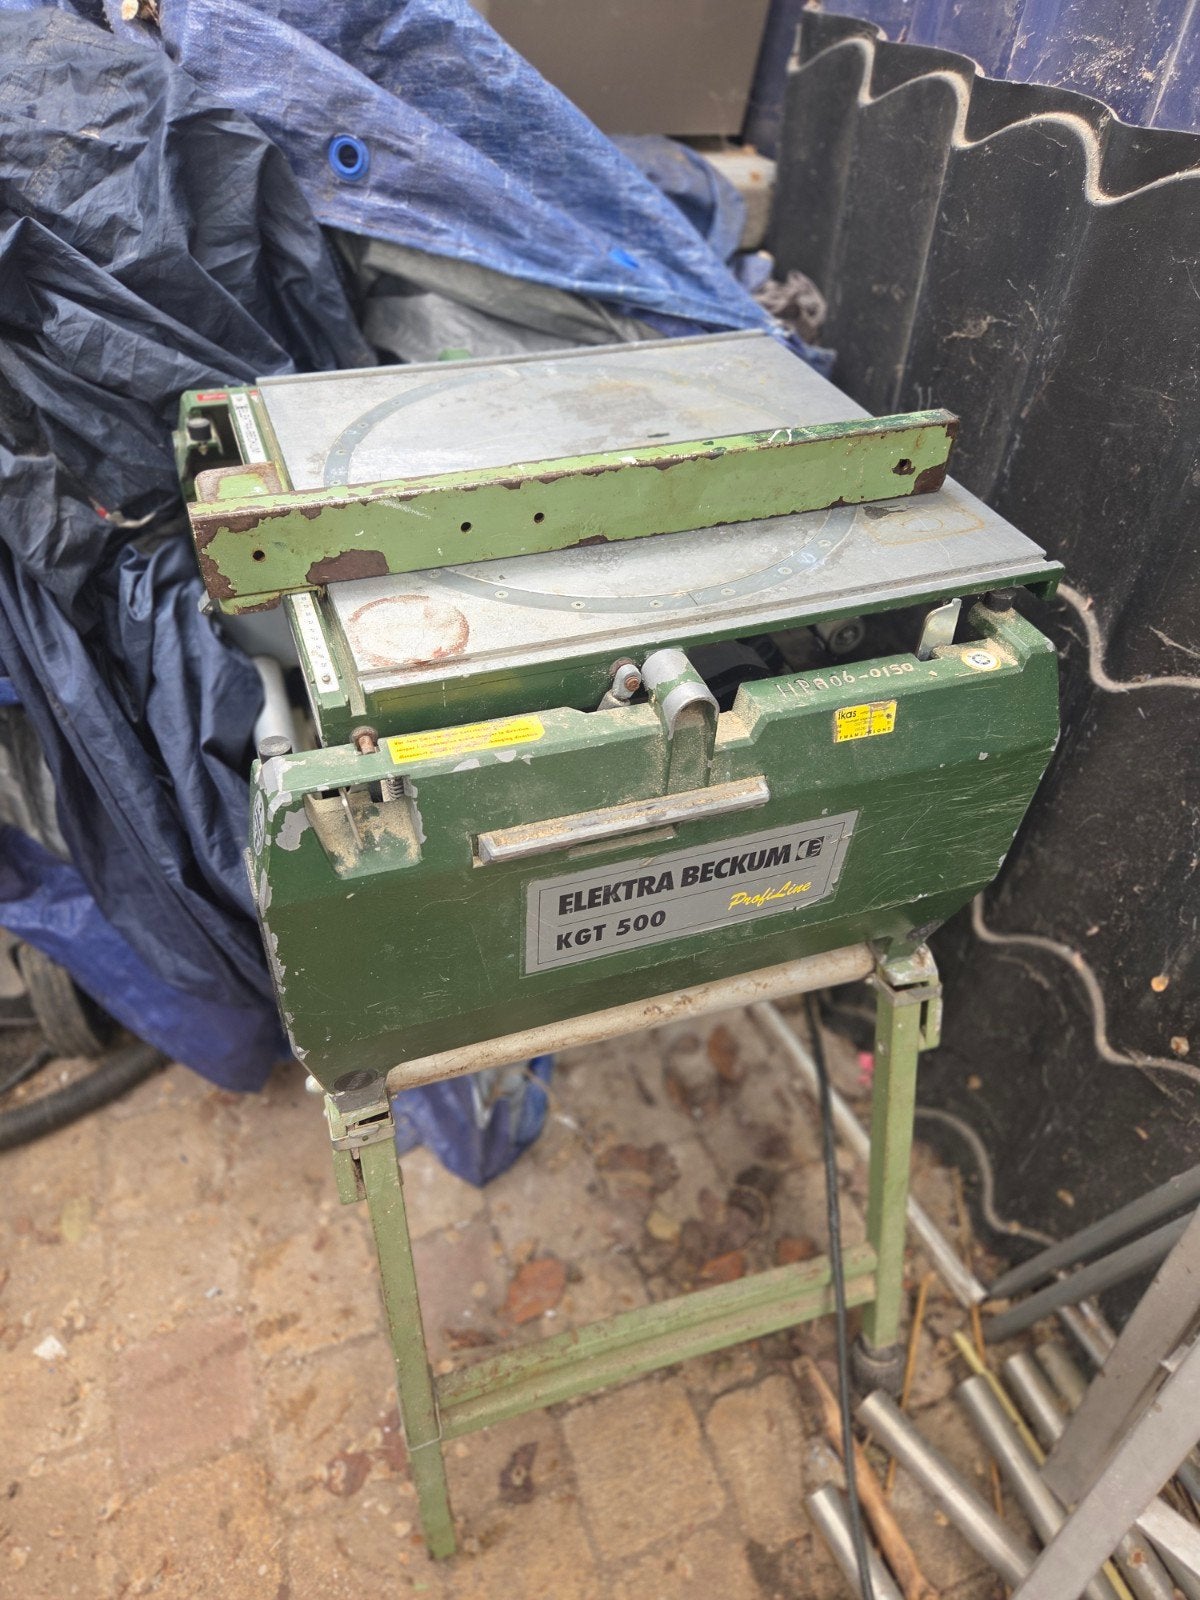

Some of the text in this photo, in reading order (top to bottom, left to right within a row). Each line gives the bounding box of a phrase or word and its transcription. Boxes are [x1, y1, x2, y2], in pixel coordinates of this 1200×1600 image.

[558, 871, 675, 915] ELEKTRA
[680, 843, 792, 888] BECKUM
[728, 881, 812, 911] ProfiLine
[556, 910, 666, 951] KGT 500
